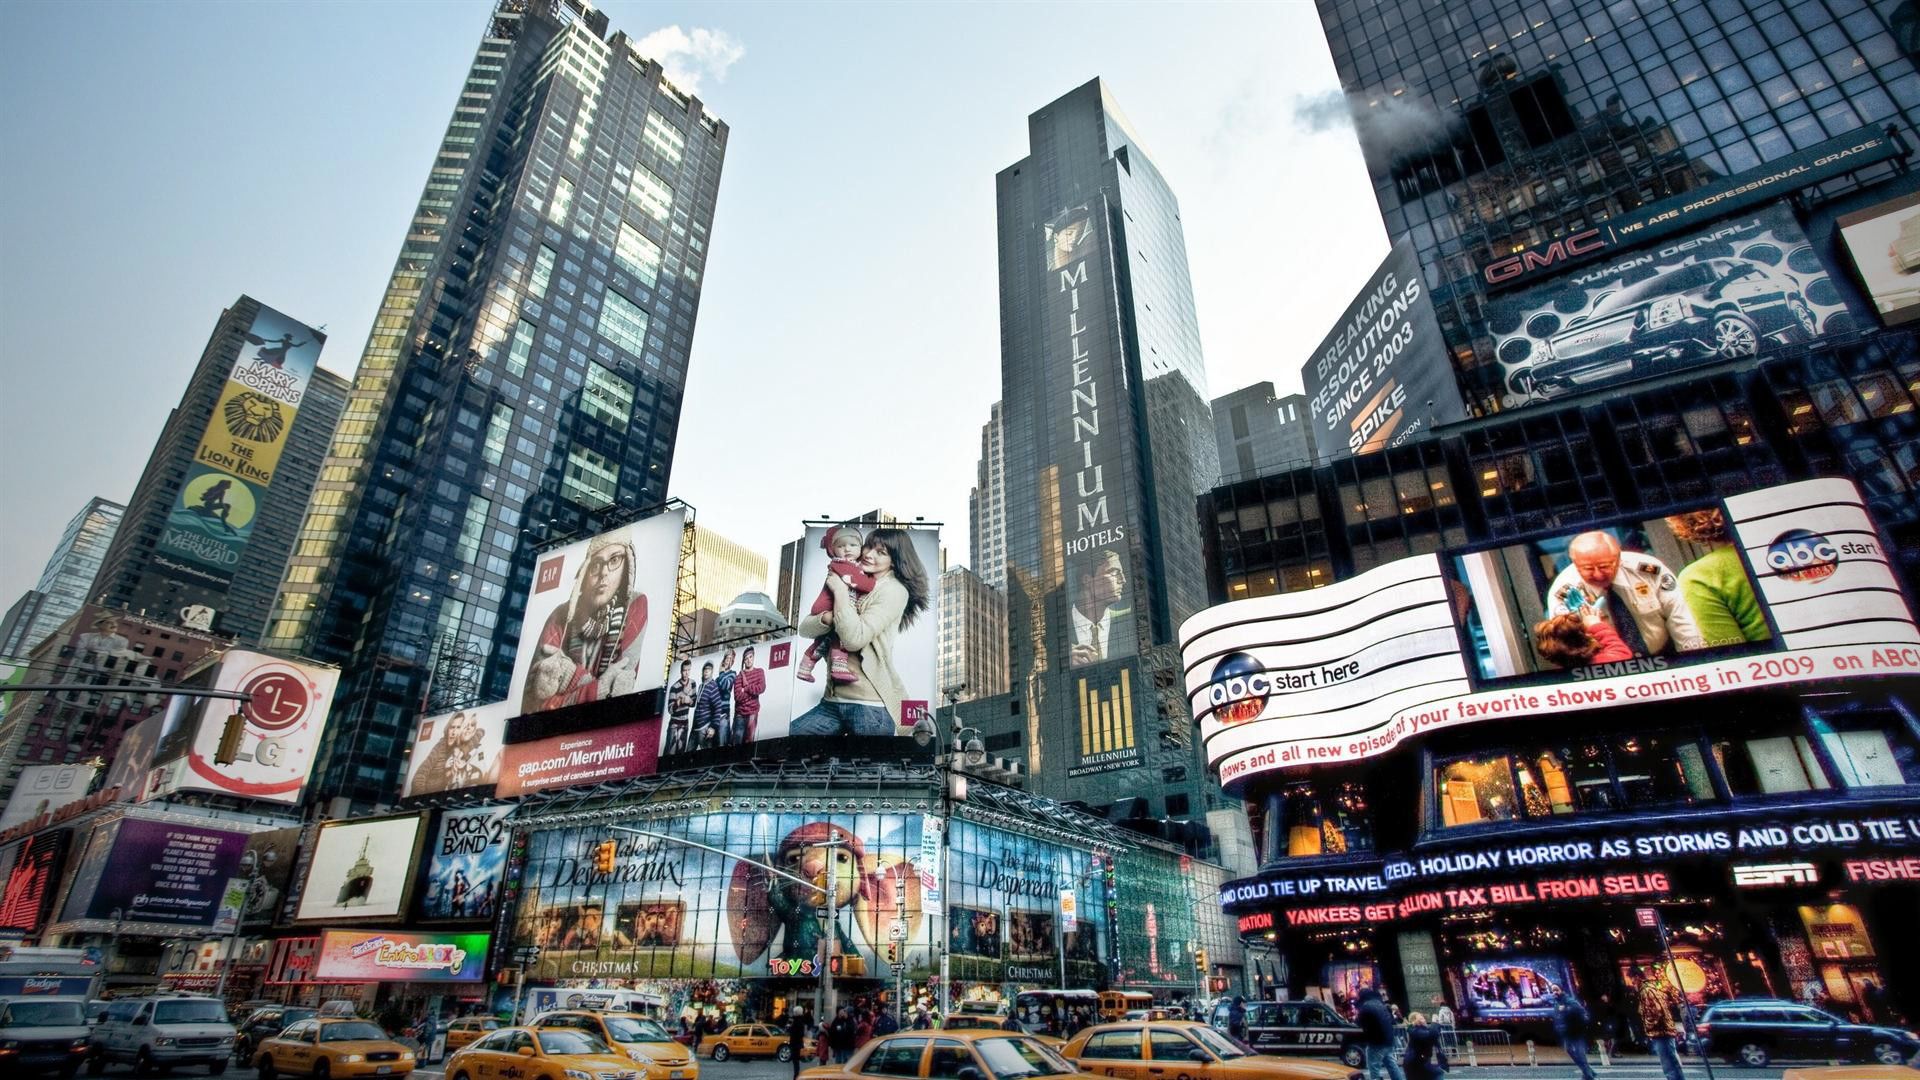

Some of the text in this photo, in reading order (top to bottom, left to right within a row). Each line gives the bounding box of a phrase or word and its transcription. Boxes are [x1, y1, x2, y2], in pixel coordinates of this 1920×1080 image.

[1620, 222, 1644, 235] WE
[1648, 209, 1680, 226] ARE
[1683, 166, 1811, 213] PROFESSIONAL
[1484, 228, 1606, 284] GMC
[1571, 218, 1762, 285] YUKON DENALI
[1317, 272, 1397, 381] BREAKING
[1310, 278, 1420, 420] RESOLUTIONS
[234, 367, 301, 404] POPPINS
[250, 361, 298, 388] MARY
[1326, 321, 1413, 430] SINCE 2003
[1060, 260, 1110, 532] MILLENNIUM
[1349, 384, 1407, 453] SPIKE
[1391, 418, 1421, 448] ACTION
[201, 445, 270, 481] LION KING
[231, 443, 255, 459] THE
[162, 530, 239, 565] MERMAID
[183, 530, 201, 542] THE
[1066, 525, 1124, 556] HOTELS
[1767, 541, 1879, 572] abc start
[542, 567, 557, 582] GAP
[774, 651, 786, 661] GAP
[1572, 655, 1668, 682] SIEMENS
[1210, 660, 1359, 706] abc start here
[1250, 749, 1276, 769] and
[1282, 746, 1301, 762] all
[1307, 745, 1342, 758] new
[1396, 716, 1406, 734] of
[1410, 708, 1449, 733] your
[1458, 693, 1539, 718] favorite
[1547, 689, 1616, 707] shows
[1625, 674, 1711, 700] coming
[1716, 667, 1742, 686] in
[1748, 655, 1815, 681] 2009
[1833, 655, 1864, 670] on
[560, 739, 592, 750] Experience
[1082, 748, 1137, 765] MILLENNIUM
[518, 742, 634, 777] gap.com/MerryMixIt
[1069, 760, 1140, 776] BROADWAY NEW YORK
[527, 777, 550, 787] surprise
[550, 775, 562, 784] cast
[563, 773, 570, 781] of
[570, 771, 595, 781] carolers
[595, 767, 608, 776] and
[608, 766, 625, 774] more
[441, 820, 505, 856] BAND 2
[447, 816, 491, 837] ROCK
[163, 848, 184, 856] PLANET
[615, 836, 644, 858] Tale
[647, 839, 664, 863] of
[1000, 846, 1021, 870] The
[1045, 856, 1057, 876] of
[1421, 852, 1500, 876] HOLIDAY
[1508, 842, 1595, 866] HORROR
[1601, 840, 1631, 858] AS
[1637, 832, 1731, 856] STORMS
[1738, 828, 1788, 848] AND
[1794, 823, 1860, 845] COLD
[1863, 820, 1906, 839] TIE
[1237, 884, 1268, 900] COLD
[1271, 880, 1296, 896] TIE
[1299, 878, 1321, 894] UP
[1323, 876, 1387, 893] TRAVEL
[1733, 862, 1819, 886] ESPN
[150, 896, 173, 904] planet
[175, 897, 212, 907] hollywood
[1445, 888, 1488, 907] TAX
[1490, 884, 1535, 904] BILL
[1537, 878, 1599, 900] FROM
[1605, 872, 1670, 894] SELIG
[1287, 907, 1361, 926] YANKEES
[1365, 904, 1396, 921] GET
[572, 960, 639, 974] CHRISTMAS
[1008, 965, 1052, 979] CHRISTMAS
[25, 978, 62, 990] Budget
[1298, 1032, 1335, 1044] NYPD
